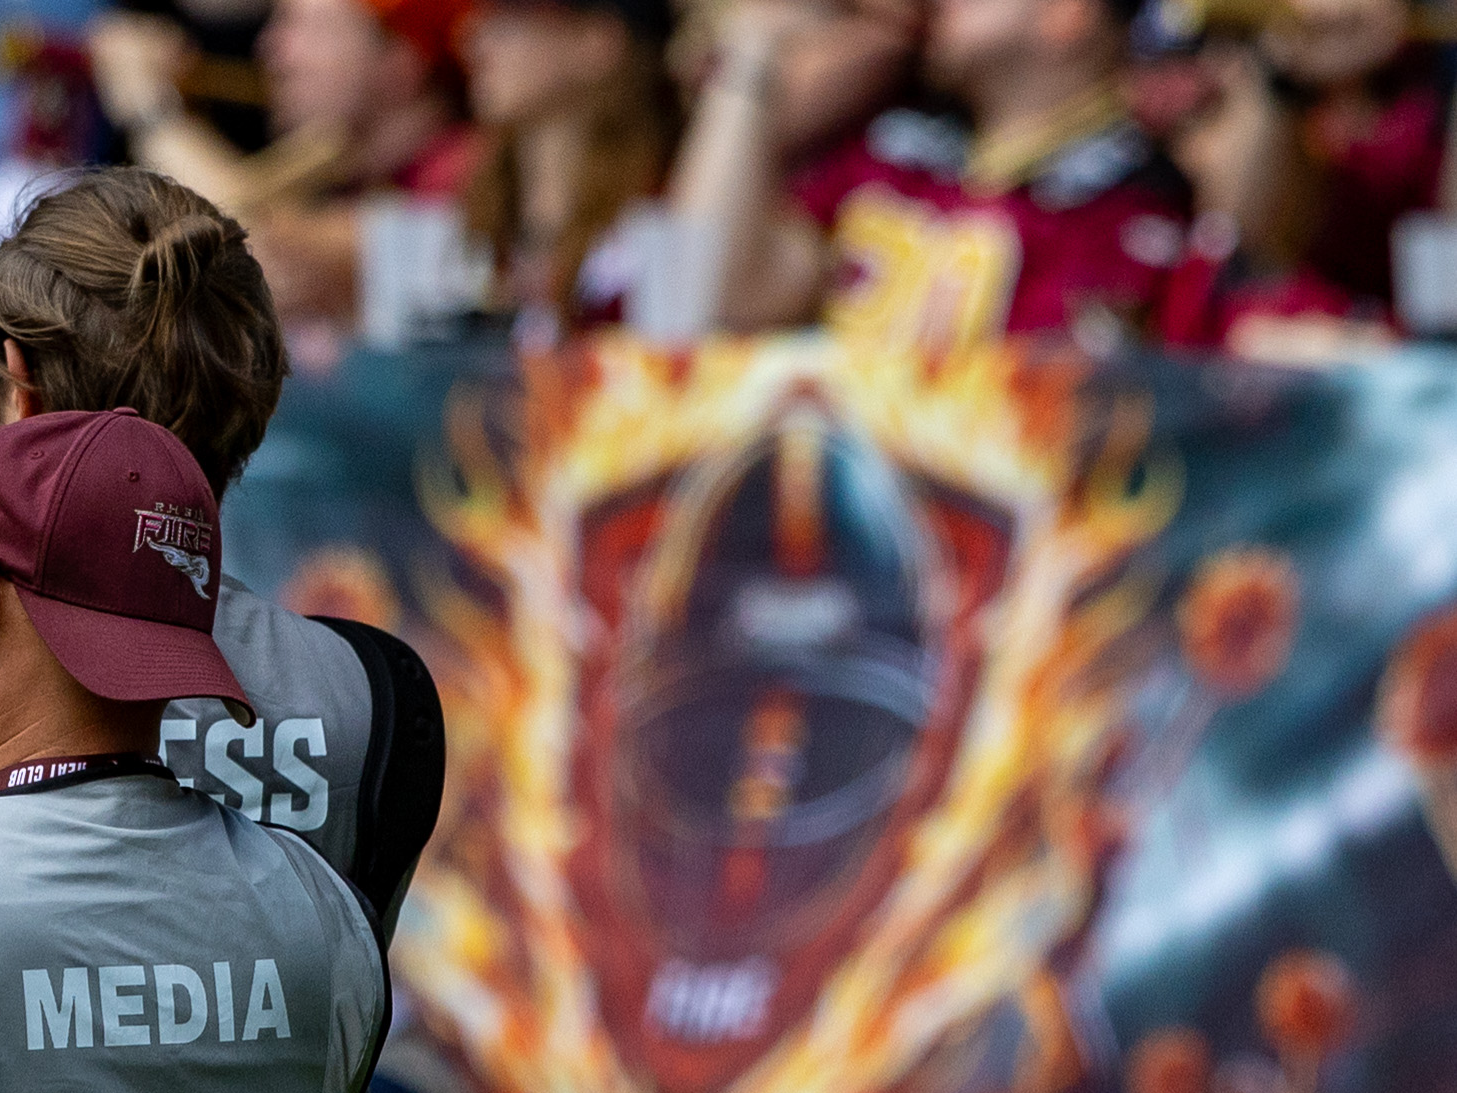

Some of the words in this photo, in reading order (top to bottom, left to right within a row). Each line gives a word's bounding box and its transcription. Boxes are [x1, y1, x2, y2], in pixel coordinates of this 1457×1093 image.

[132, 509, 213, 554] FIRE
[7, 764, 45, 788] CLUB
[22, 958, 292, 1050] MEDIA
